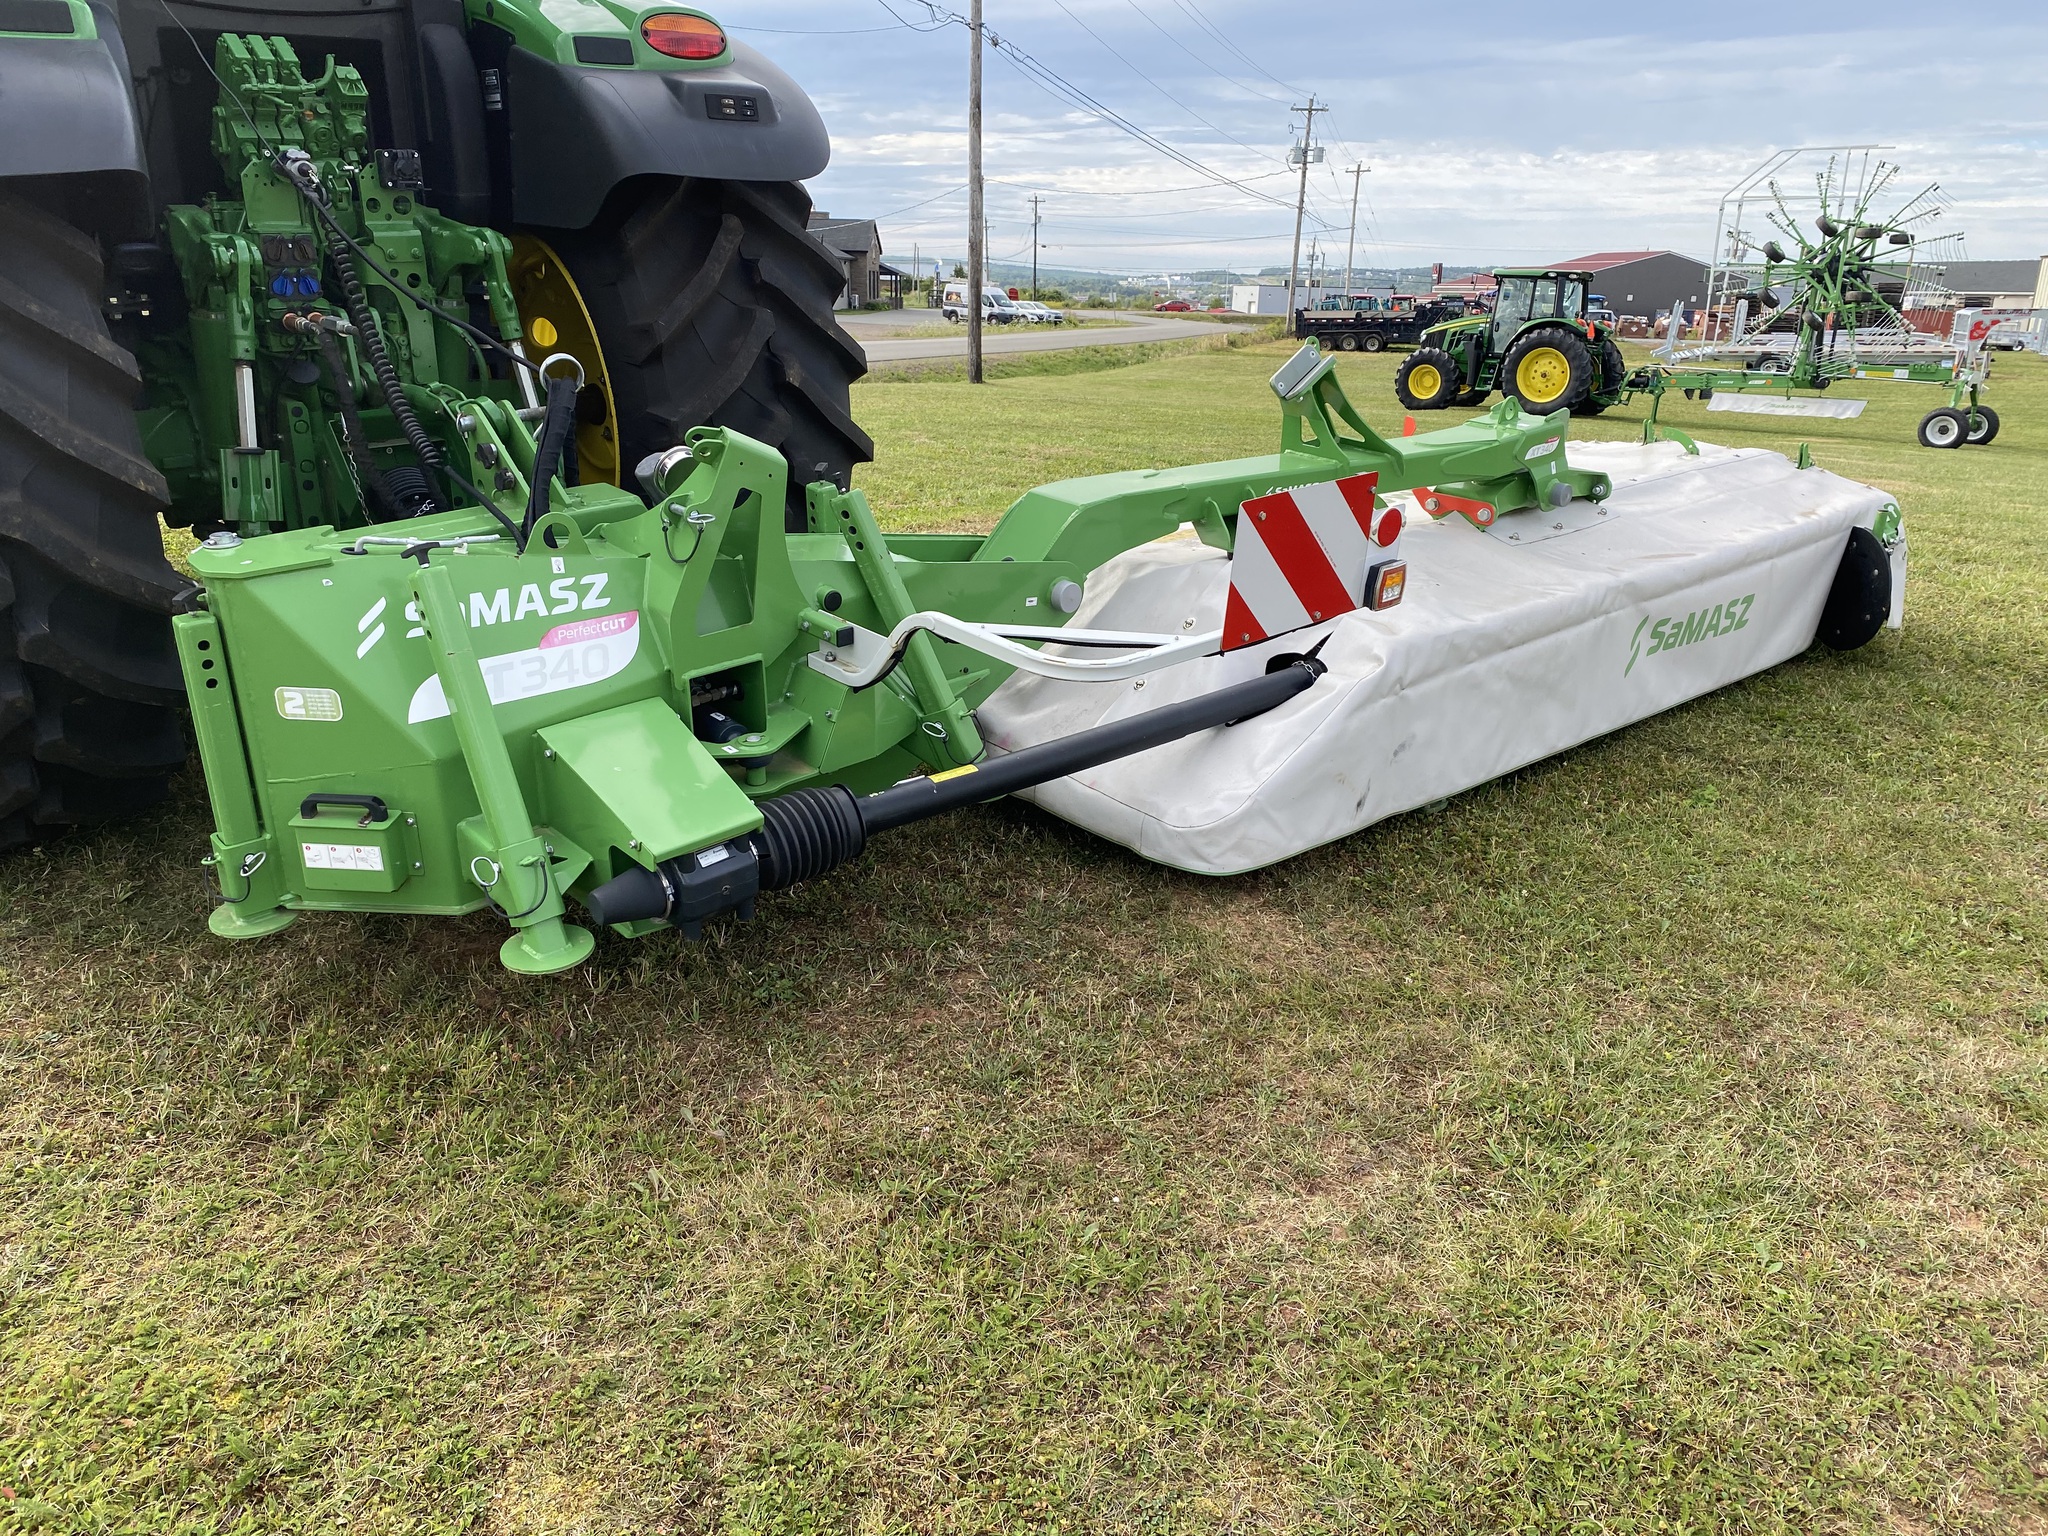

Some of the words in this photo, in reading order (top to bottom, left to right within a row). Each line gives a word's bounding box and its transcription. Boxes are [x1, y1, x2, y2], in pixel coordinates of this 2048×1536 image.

[405, 573, 611, 638] SMASZ
[1646, 593, 1755, 657] SaMASZ
[484, 643, 610, 700] T340
[284, 691, 306, 714] 2
